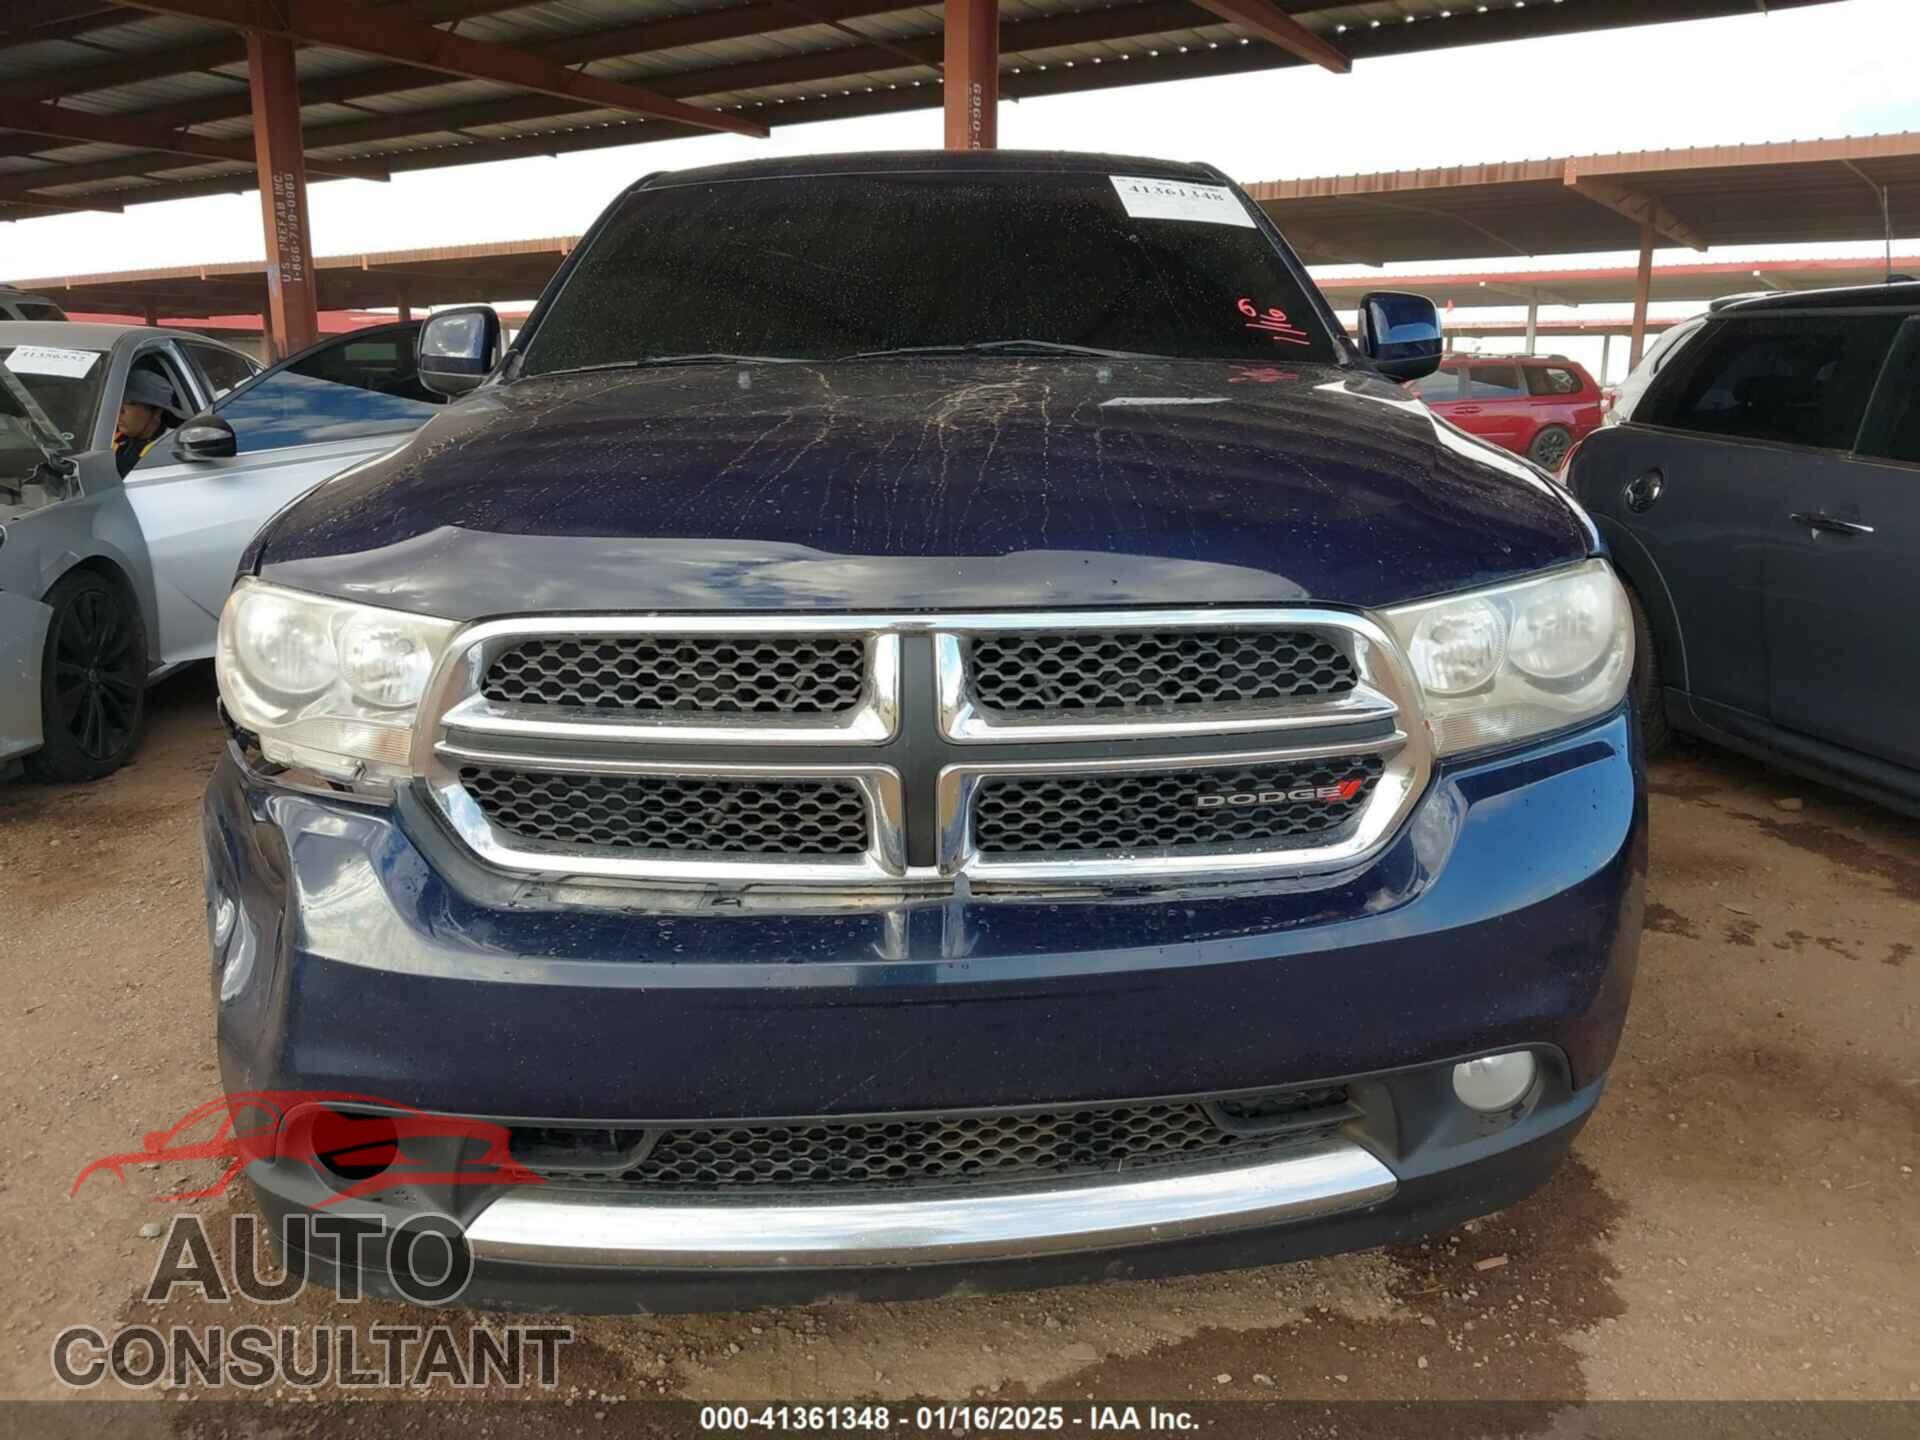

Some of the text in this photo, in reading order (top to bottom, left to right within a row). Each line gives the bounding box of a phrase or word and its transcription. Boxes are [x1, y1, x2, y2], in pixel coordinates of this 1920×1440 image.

[276, 201, 289, 252] PREFAB
[284, 173, 303, 282] 1-866-799-0969
[280, 258, 292, 283] U.S.
[1197, 785, 1342, 807] DODGE
